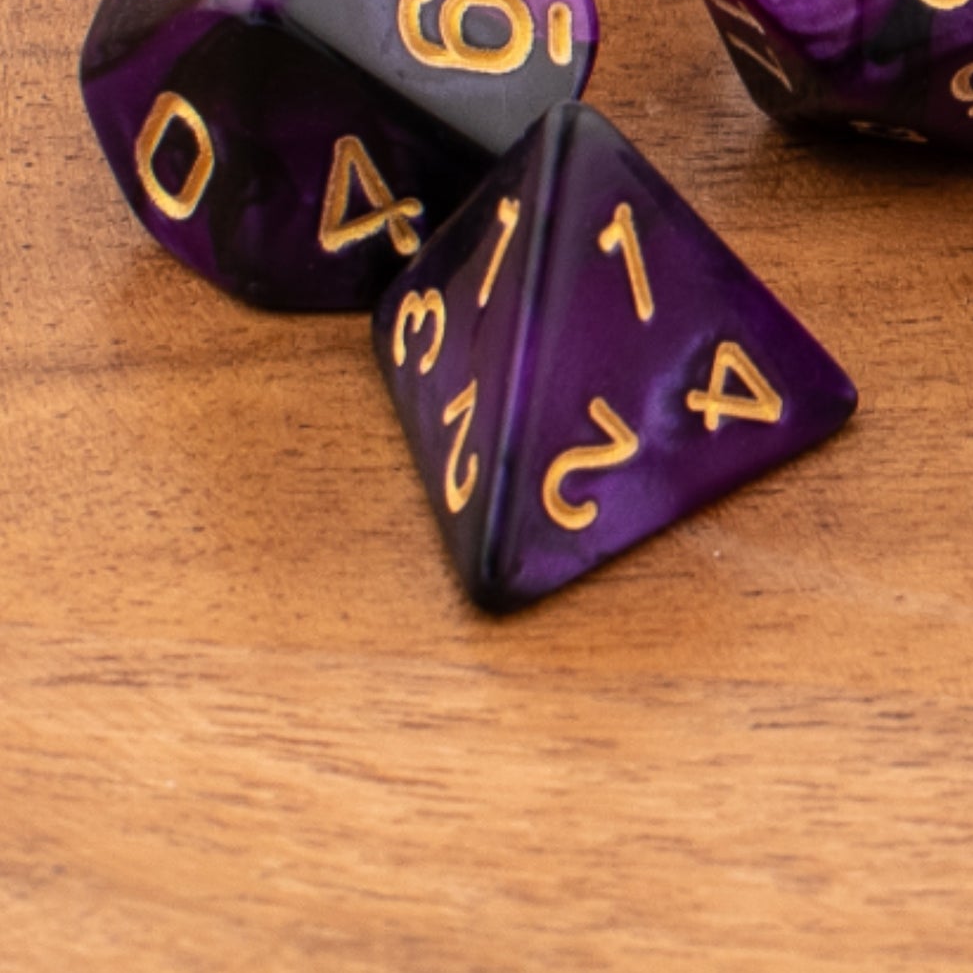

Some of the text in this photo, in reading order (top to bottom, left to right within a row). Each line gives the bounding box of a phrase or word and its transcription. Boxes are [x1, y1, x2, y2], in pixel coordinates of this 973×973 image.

[135, 90, 214, 220] 0
[318, 135, 423, 256] 4
[479, 196, 520, 307] 1
[598, 202, 655, 321] 1
[391, 287, 446, 375] 3
[686, 340, 783, 432] 4
[442, 379, 478, 514] 2
[542, 397, 640, 531] 2
